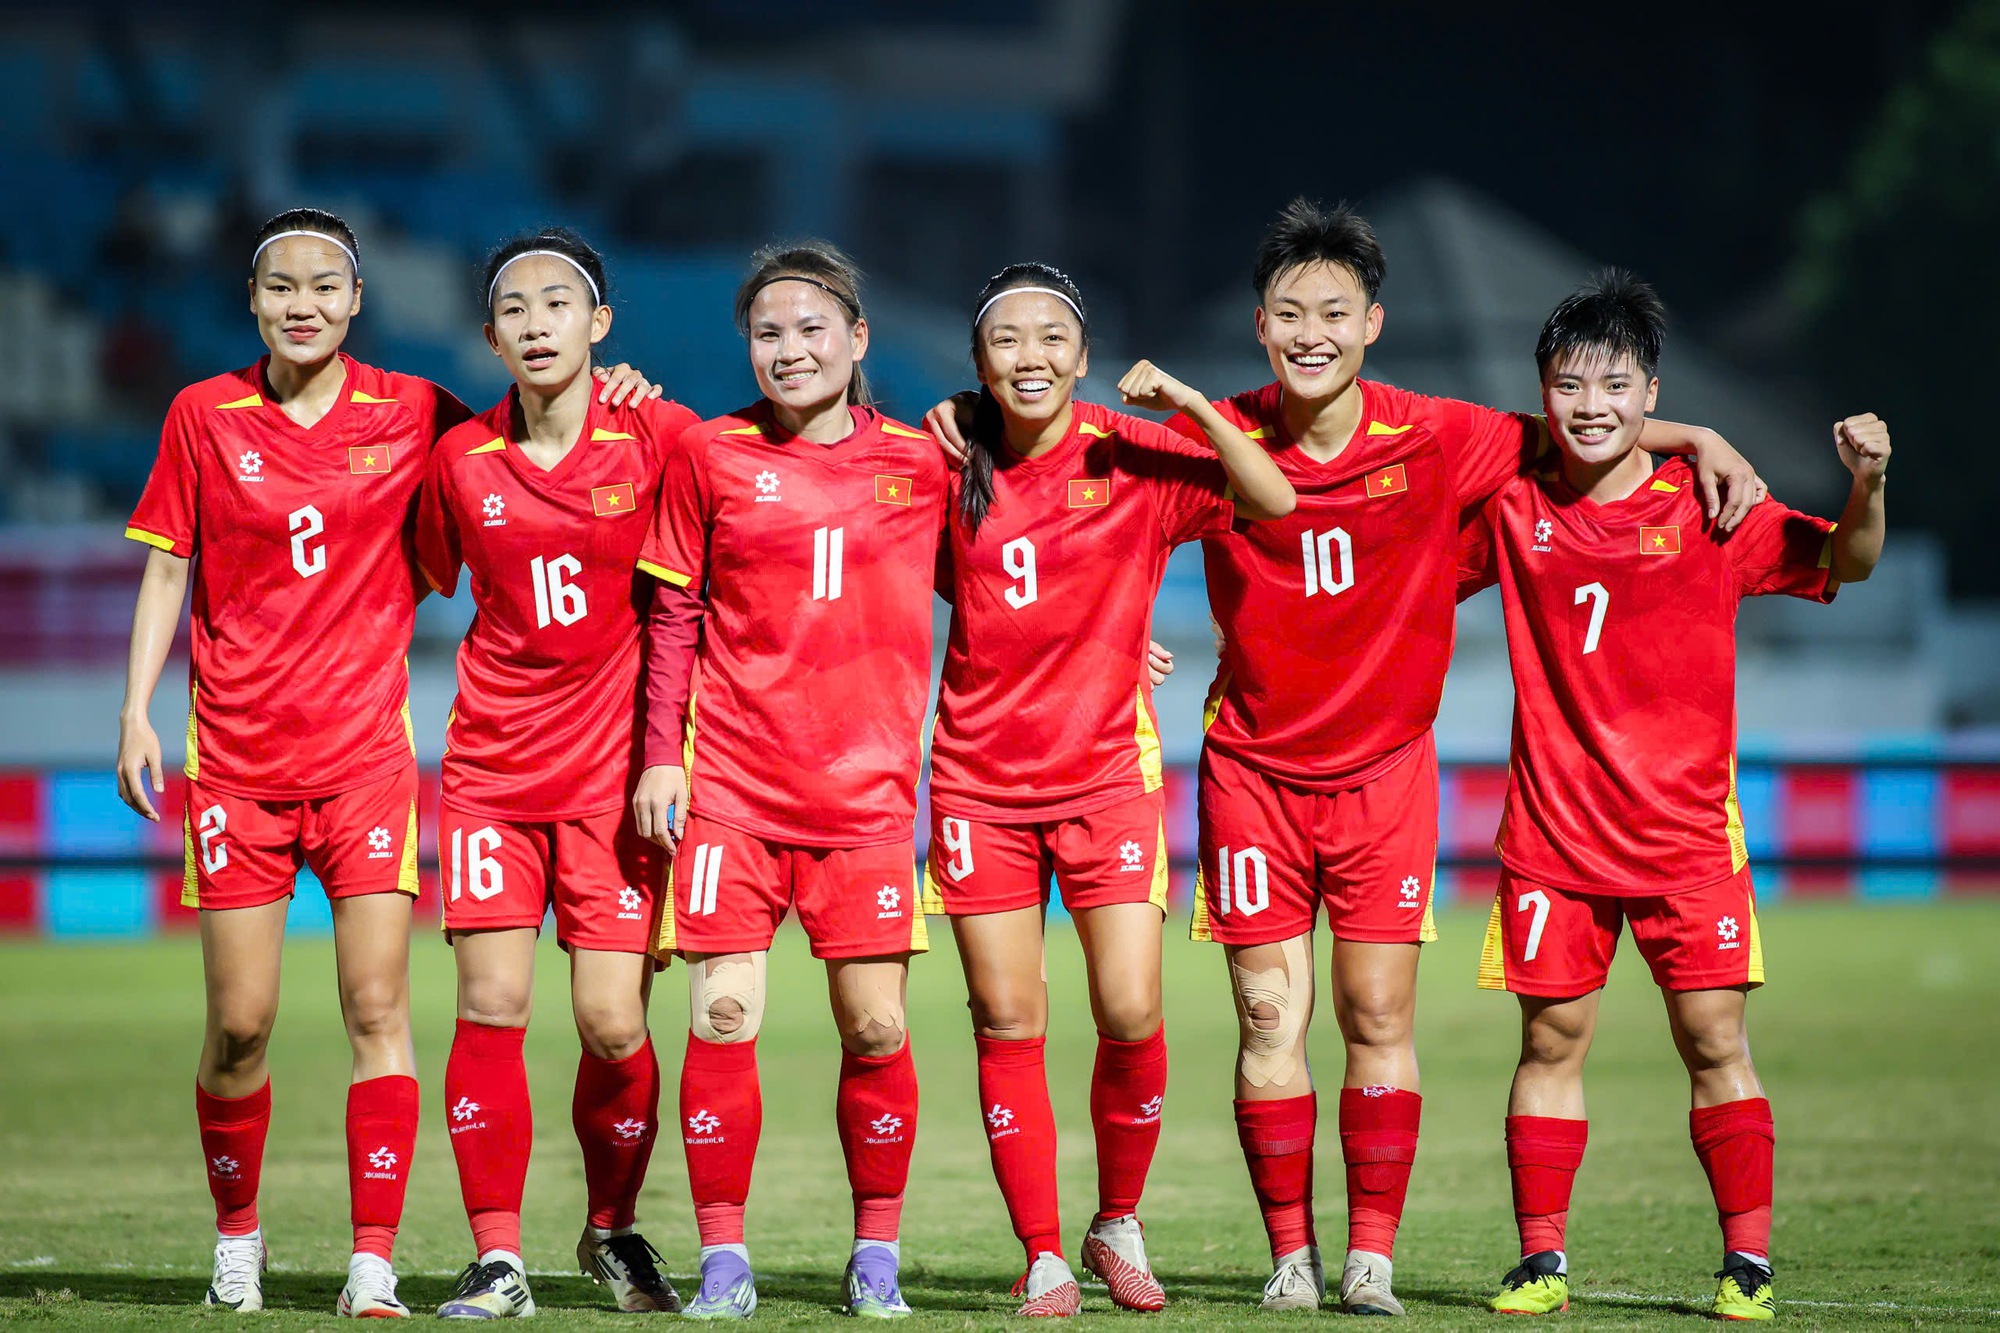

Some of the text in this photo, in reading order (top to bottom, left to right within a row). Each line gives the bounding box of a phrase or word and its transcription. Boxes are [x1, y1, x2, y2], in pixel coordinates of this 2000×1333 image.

[289, 504, 326, 578] 2
[812, 527, 845, 602] 11
[1003, 536, 1037, 610] 9
[1301, 527, 1354, 597] 10
[531, 553, 587, 629] 16
[1574, 582, 1609, 655] 7
[199, 804, 228, 875] 2
[451, 826, 504, 902] 16
[943, 817, 974, 881] 9
[689, 843, 724, 916] 11
[1217, 846, 1269, 917] 10
[1518, 890, 1550, 962] 7
